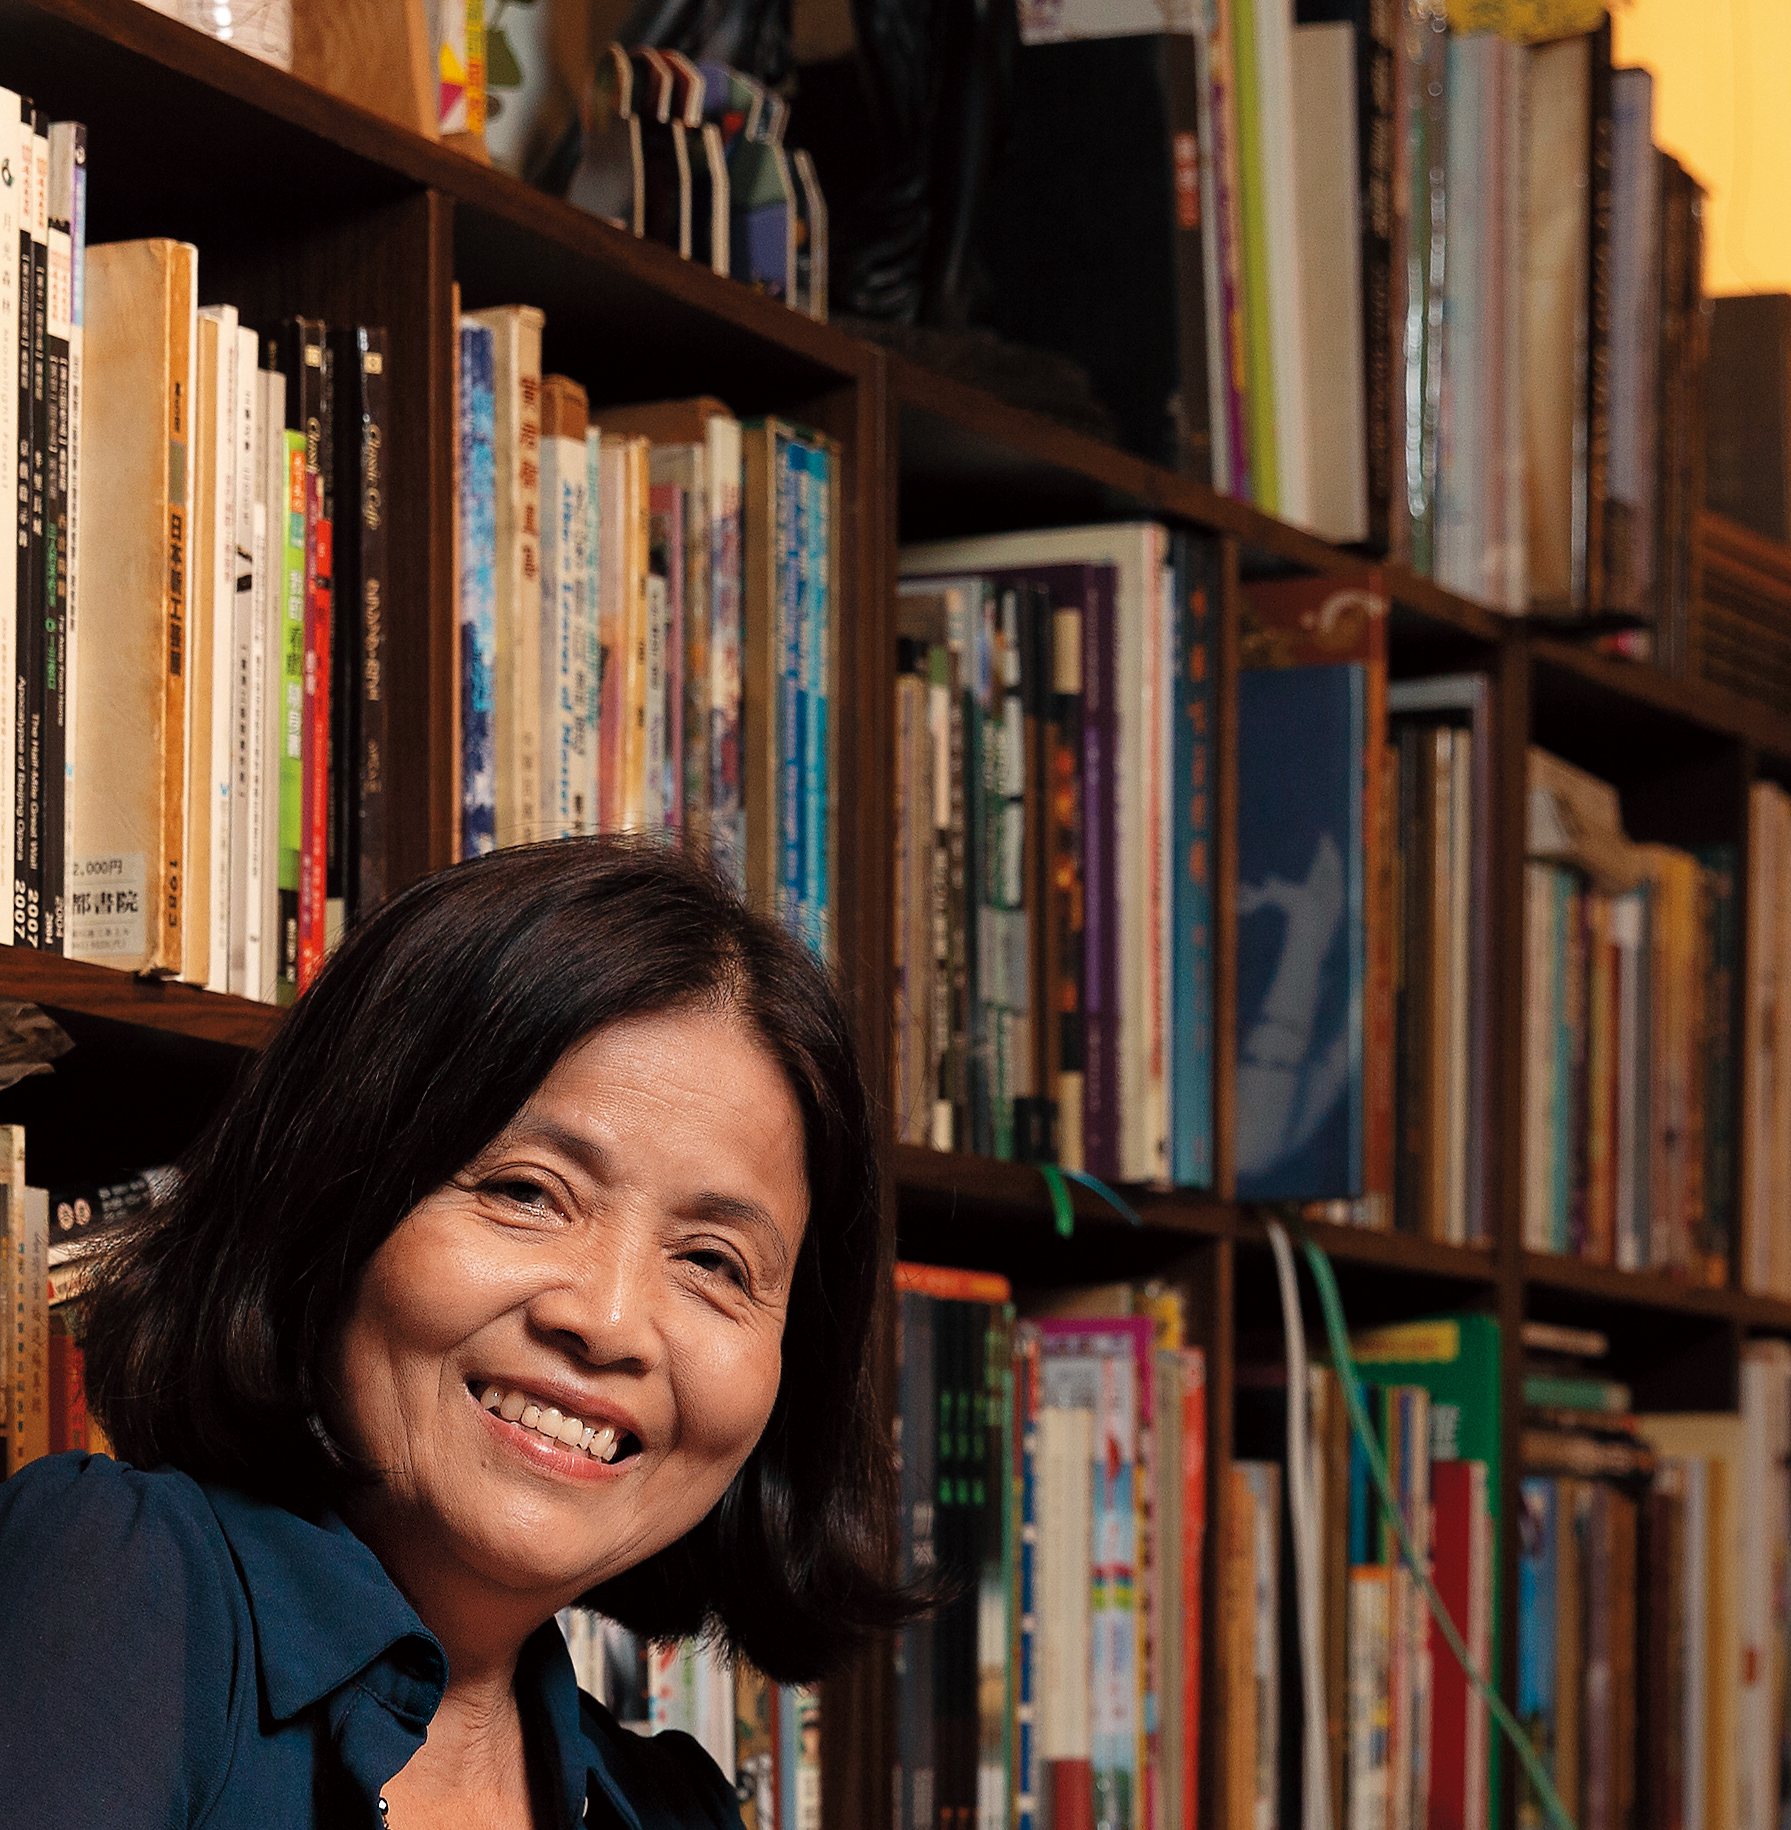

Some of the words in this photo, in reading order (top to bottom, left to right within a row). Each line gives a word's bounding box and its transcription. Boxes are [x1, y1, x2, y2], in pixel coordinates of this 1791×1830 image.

[14, 879, 26, 940] 2007
[26, 887, 39, 949] 2007
[168, 860, 181, 929] 1983
